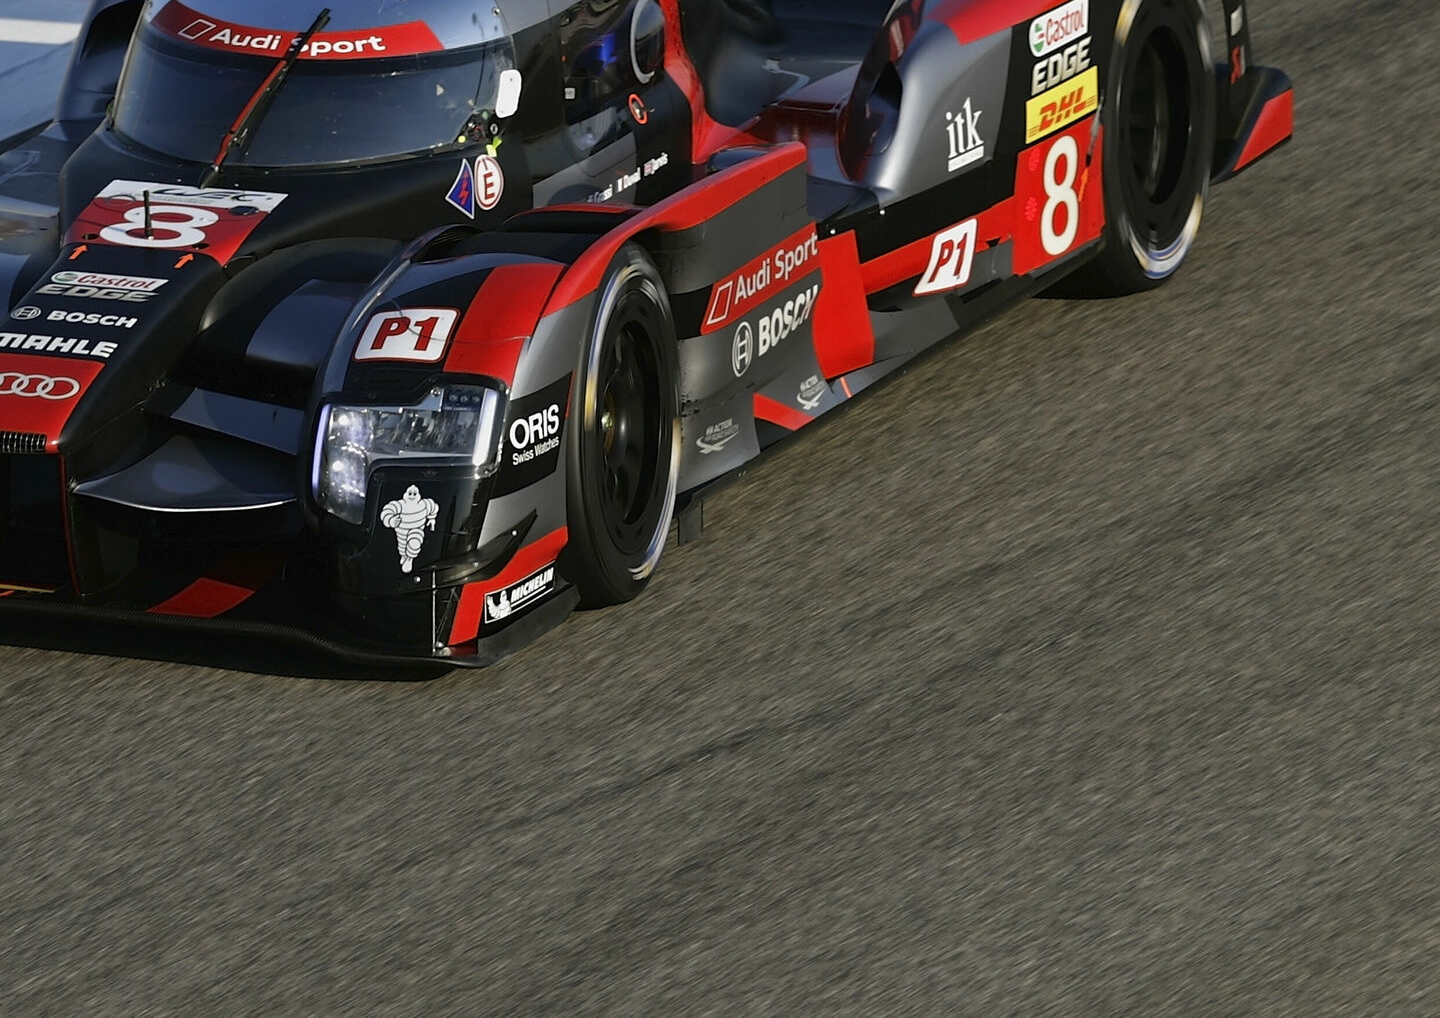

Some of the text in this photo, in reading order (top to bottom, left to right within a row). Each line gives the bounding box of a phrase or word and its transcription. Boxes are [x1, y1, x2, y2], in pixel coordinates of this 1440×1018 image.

[209, 28, 282, 50] Audi
[1045, 2, 1085, 46] Castrol
[1031, 35, 1093, 96] EDGE
[945, 95, 985, 159] itk
[1038, 86, 1087, 132] DHL
[1041, 135, 1079, 256] 8
[99, 205, 220, 248] 8
[734, 232, 818, 305] Audi Sport
[927, 230, 969, 284] P1
[34, 284, 160, 303] EDGE
[76, 274, 160, 290] Castrol
[47, 310, 138, 329] BOSCH
[370, 316, 441, 352] P1
[758, 284, 819, 357] BOSCH
[509, 404, 560, 450] ORIS
[512, 449, 535, 466] Swiss
[510, 567, 555, 603] MICHELIN
